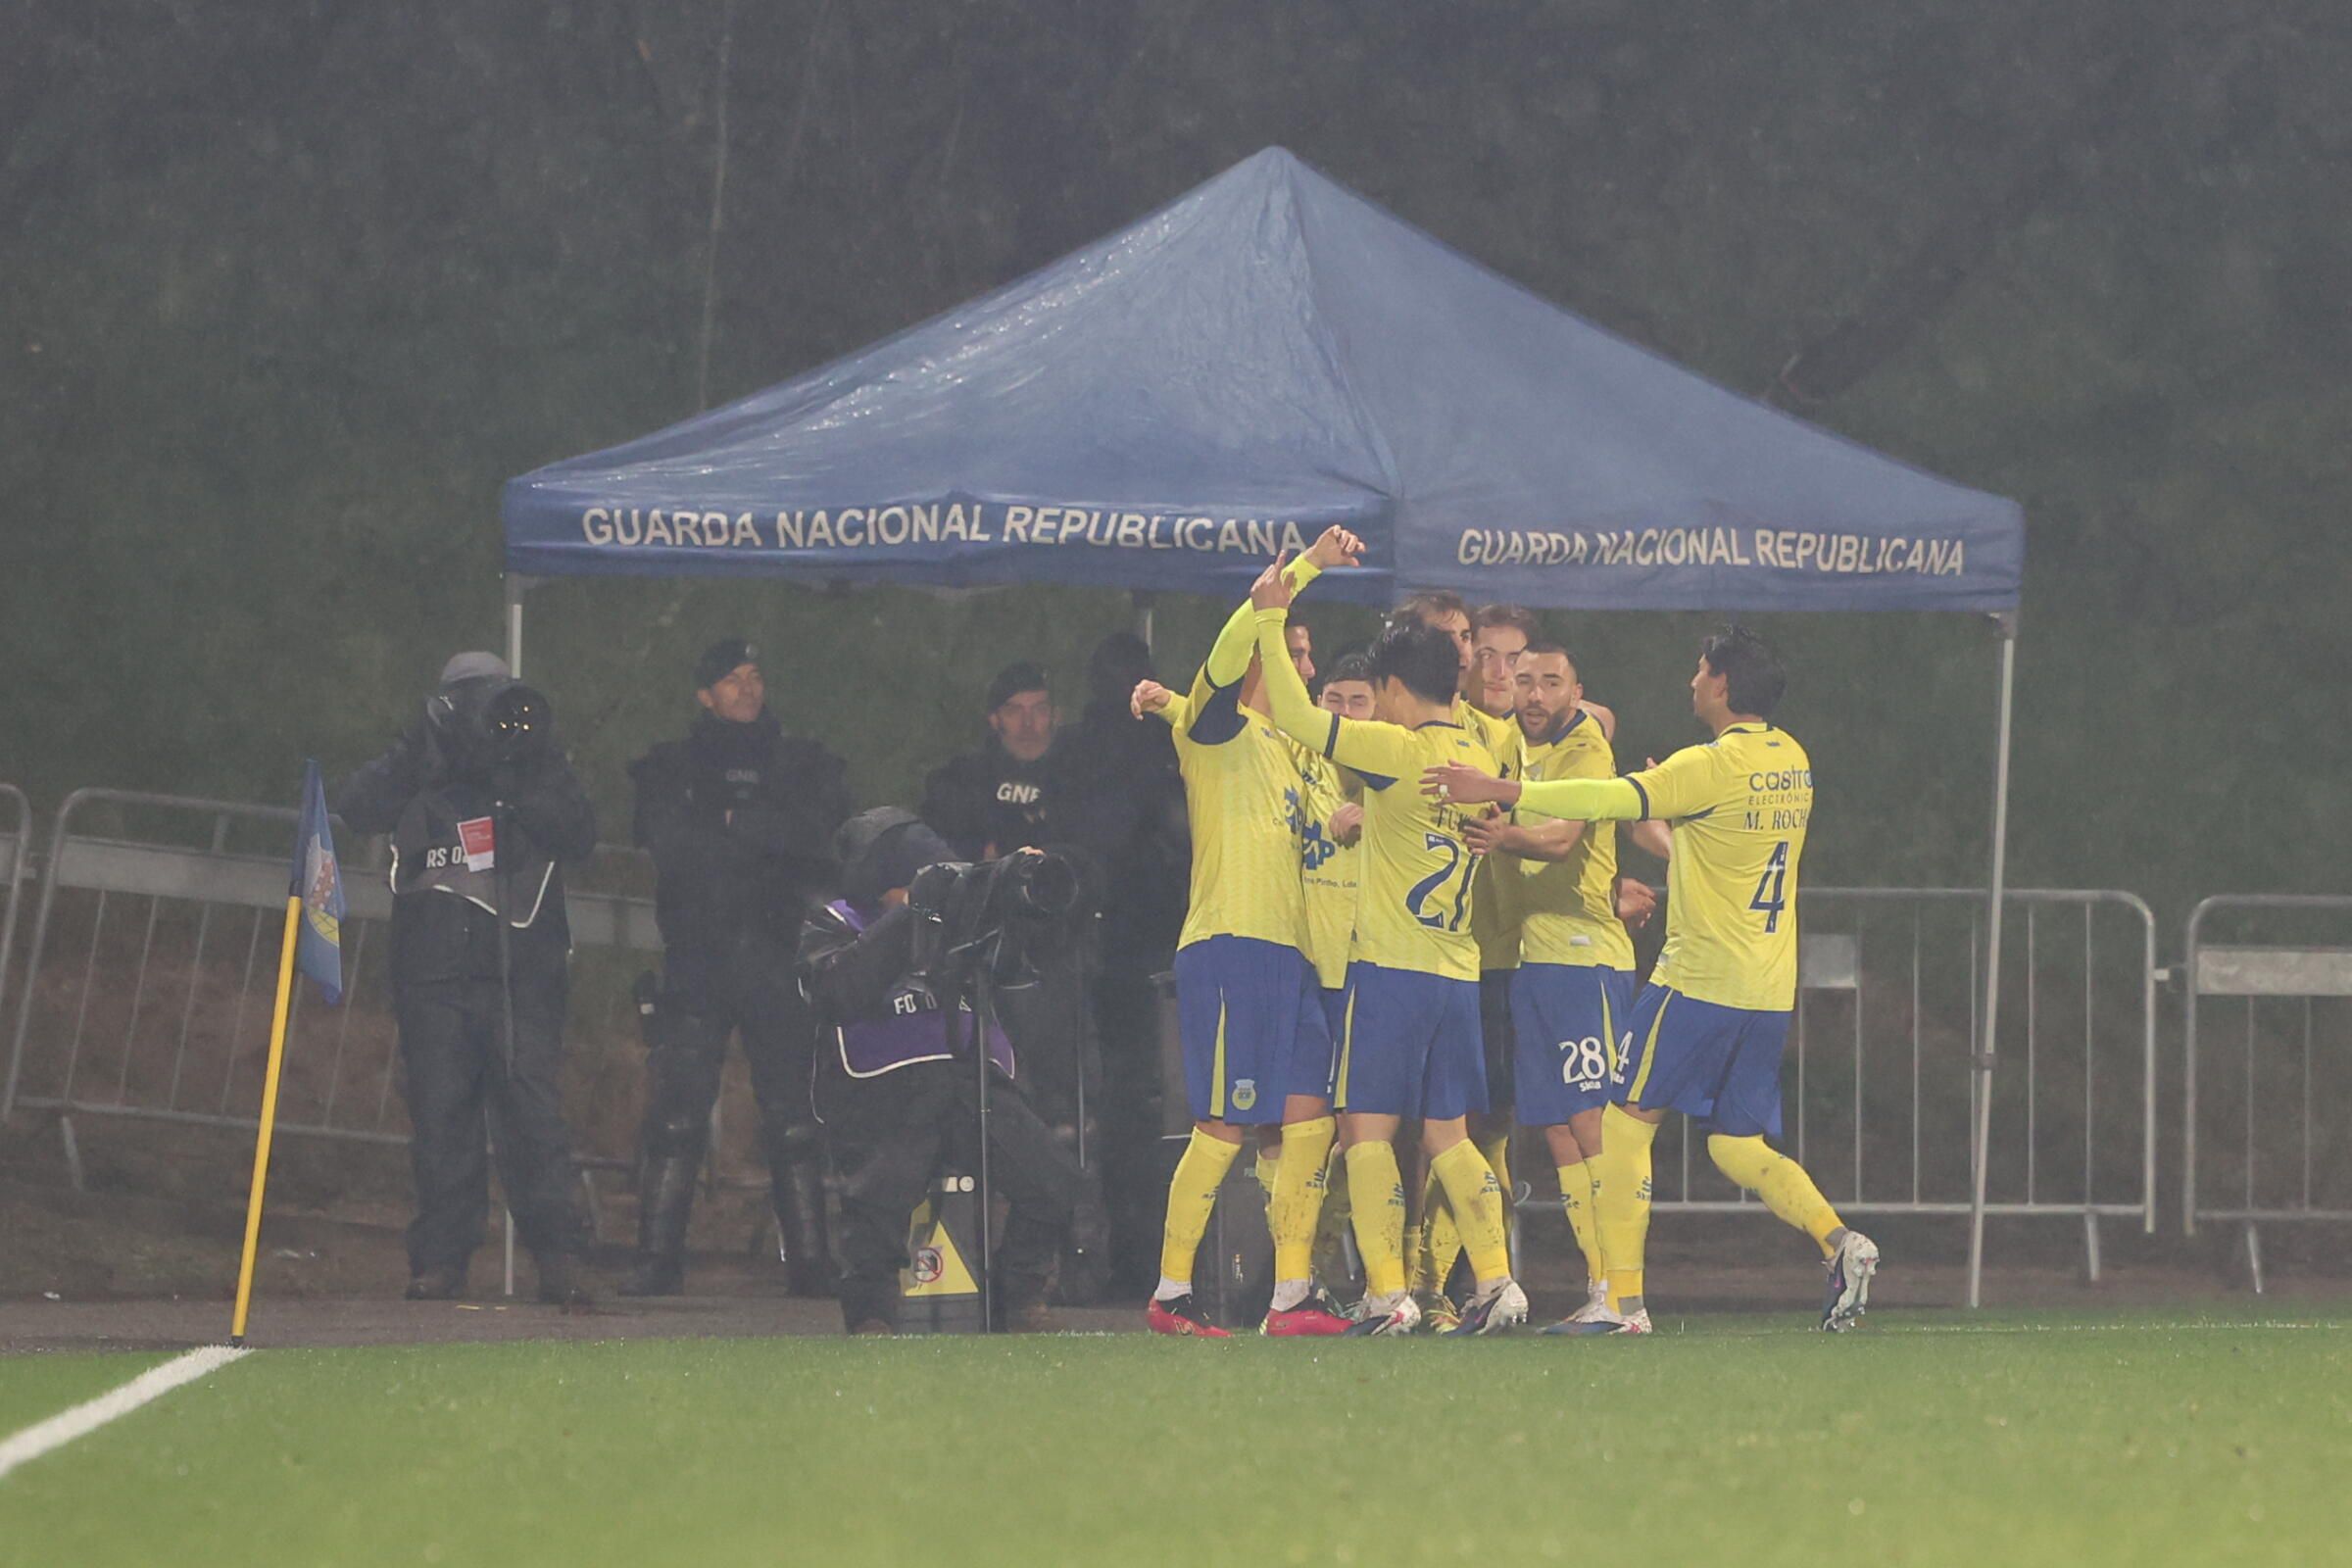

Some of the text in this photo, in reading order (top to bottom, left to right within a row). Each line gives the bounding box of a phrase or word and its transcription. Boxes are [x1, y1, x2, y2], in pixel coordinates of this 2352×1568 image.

[582, 503, 1308, 556] GUARDA NACIONAL REPUBLICANA
[1457, 527, 1964, 576] GUARDA NACIONAL REPUBLICANA
[1743, 808, 1808, 830] M. ROCH
[1748, 840, 1788, 933] 4
[1558, 1036, 1606, 1085] 28
[1617, 1030, 1634, 1072] 4
